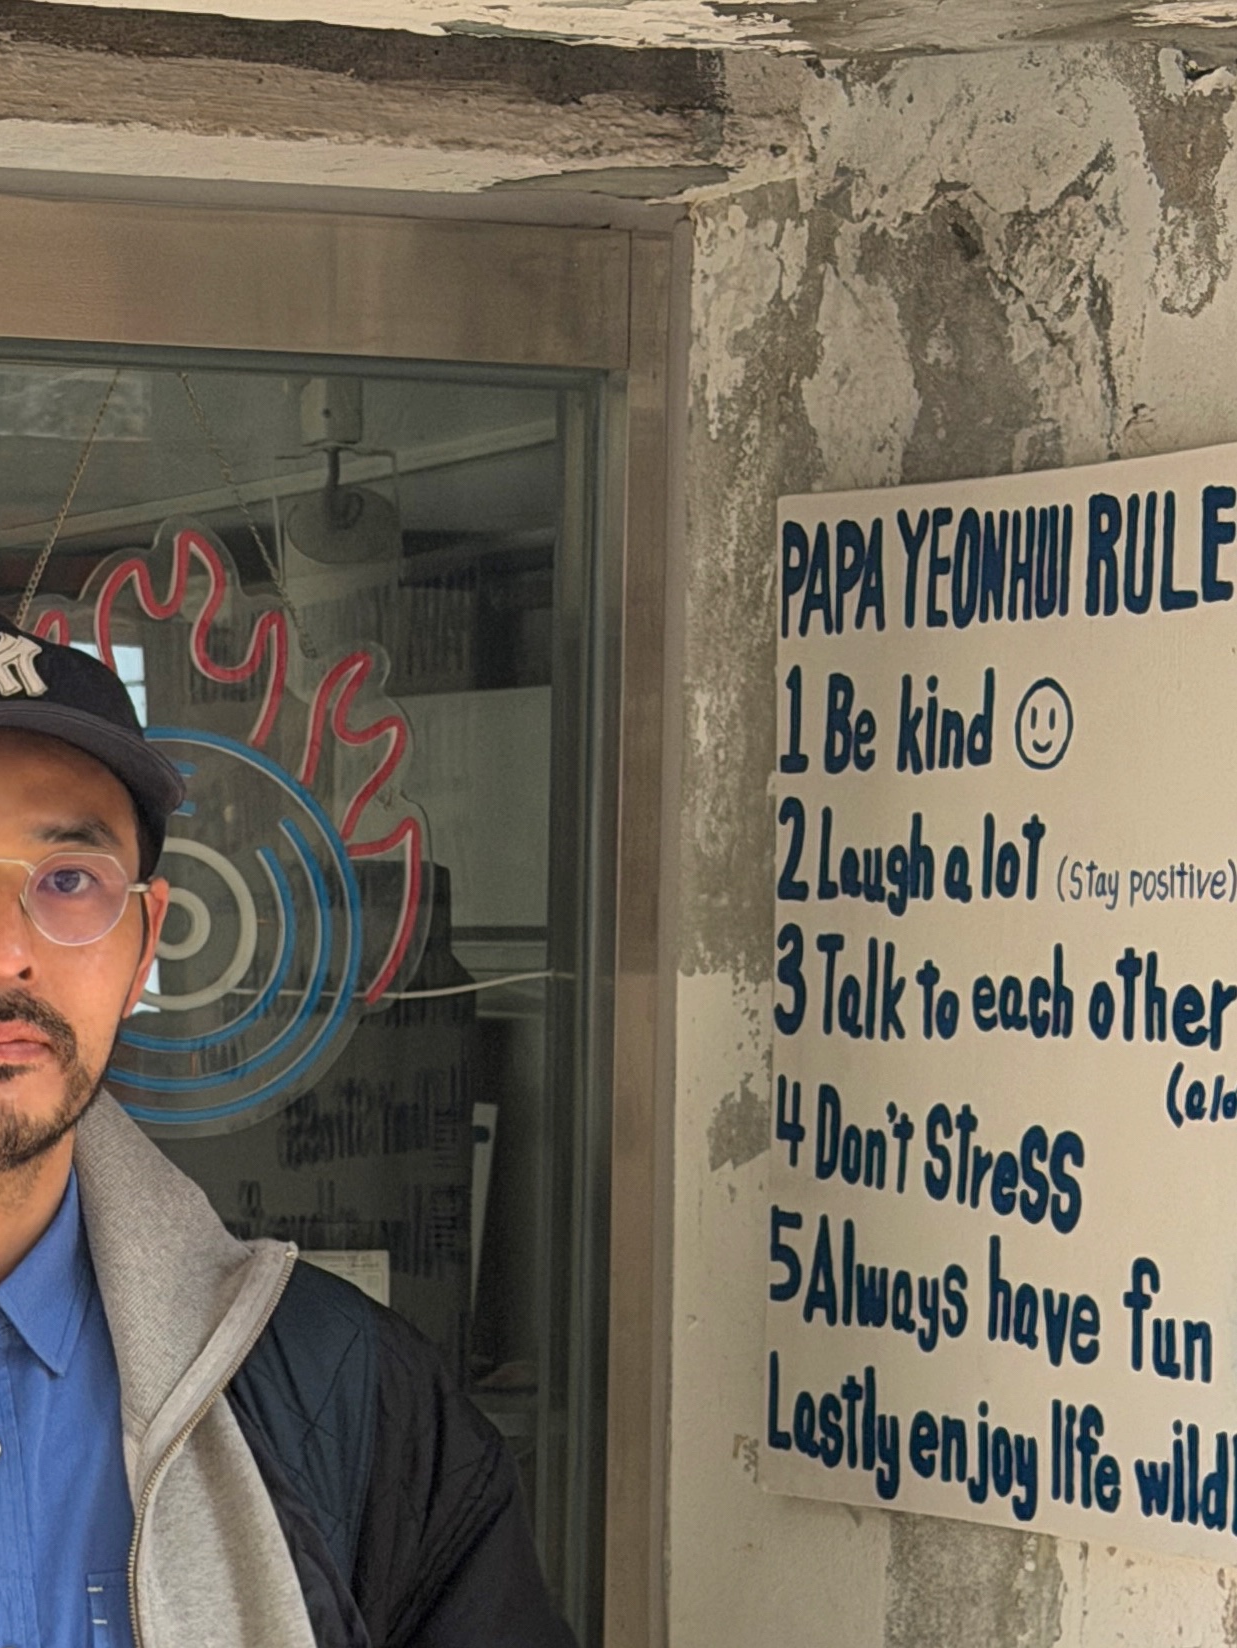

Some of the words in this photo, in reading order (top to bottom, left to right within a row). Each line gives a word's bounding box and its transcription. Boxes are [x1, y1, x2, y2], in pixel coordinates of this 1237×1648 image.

[781, 518, 886, 639] PAPA
[896, 504, 1073, 630] YEONHUI
[779, 664, 810, 774] 1
[823, 672, 877, 775] Be
[896, 667, 995, 775] kind
[776, 797, 810, 902] 2
[817, 806, 935, 917] Laugh
[943, 846, 973, 904] a
[1057, 855, 1120, 911] (Stay
[1130, 859, 1237, 907] positive)
[773, 922, 807, 1036] 3
[816, 933, 906, 1042] Talk
[915, 959, 960, 1040] to
[972, 943, 1074, 1039] each
[1088, 947, 1237, 1051] other
[775, 1074, 806, 1167] 4
[815, 1083, 915, 1194] Don't
[769, 1204, 803, 1302] 5
[802, 1213, 968, 1353] Always
[987, 1235, 1101, 1367] have
[1123, 1257, 1212, 1383] fun
[767, 1350, 901, 1501] Lastly
[908, 1401, 1038, 1522] enjoy
[1051, 1399, 1121, 1513] life
